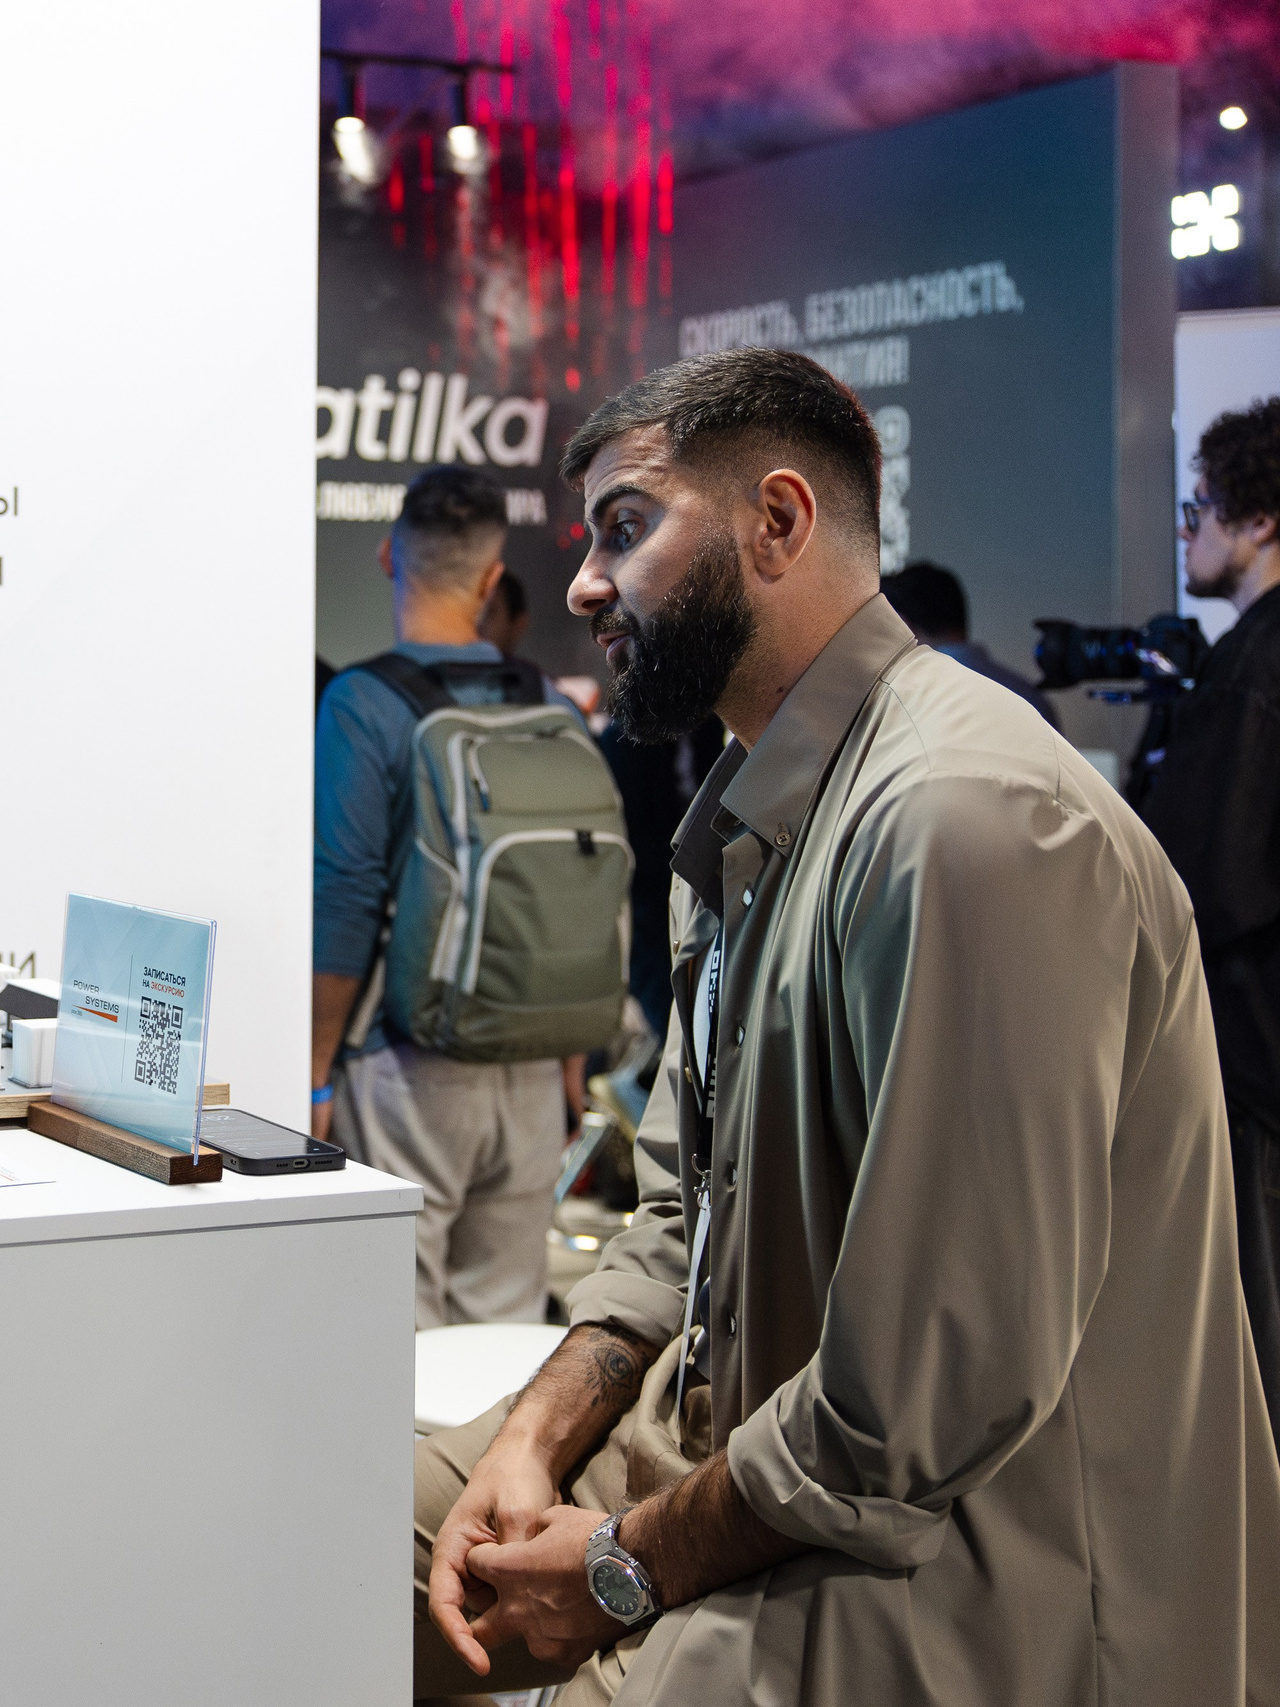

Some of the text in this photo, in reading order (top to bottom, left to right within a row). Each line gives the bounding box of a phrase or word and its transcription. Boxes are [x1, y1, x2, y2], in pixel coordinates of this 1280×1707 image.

[143, 966, 186, 987] ЗАПИСАТЬСЯ
[73, 979, 100, 995] POWER
[142, 979, 185, 998] НА ЭКСКУРСИЮ
[85, 995, 120, 1014] SYSTEMS
